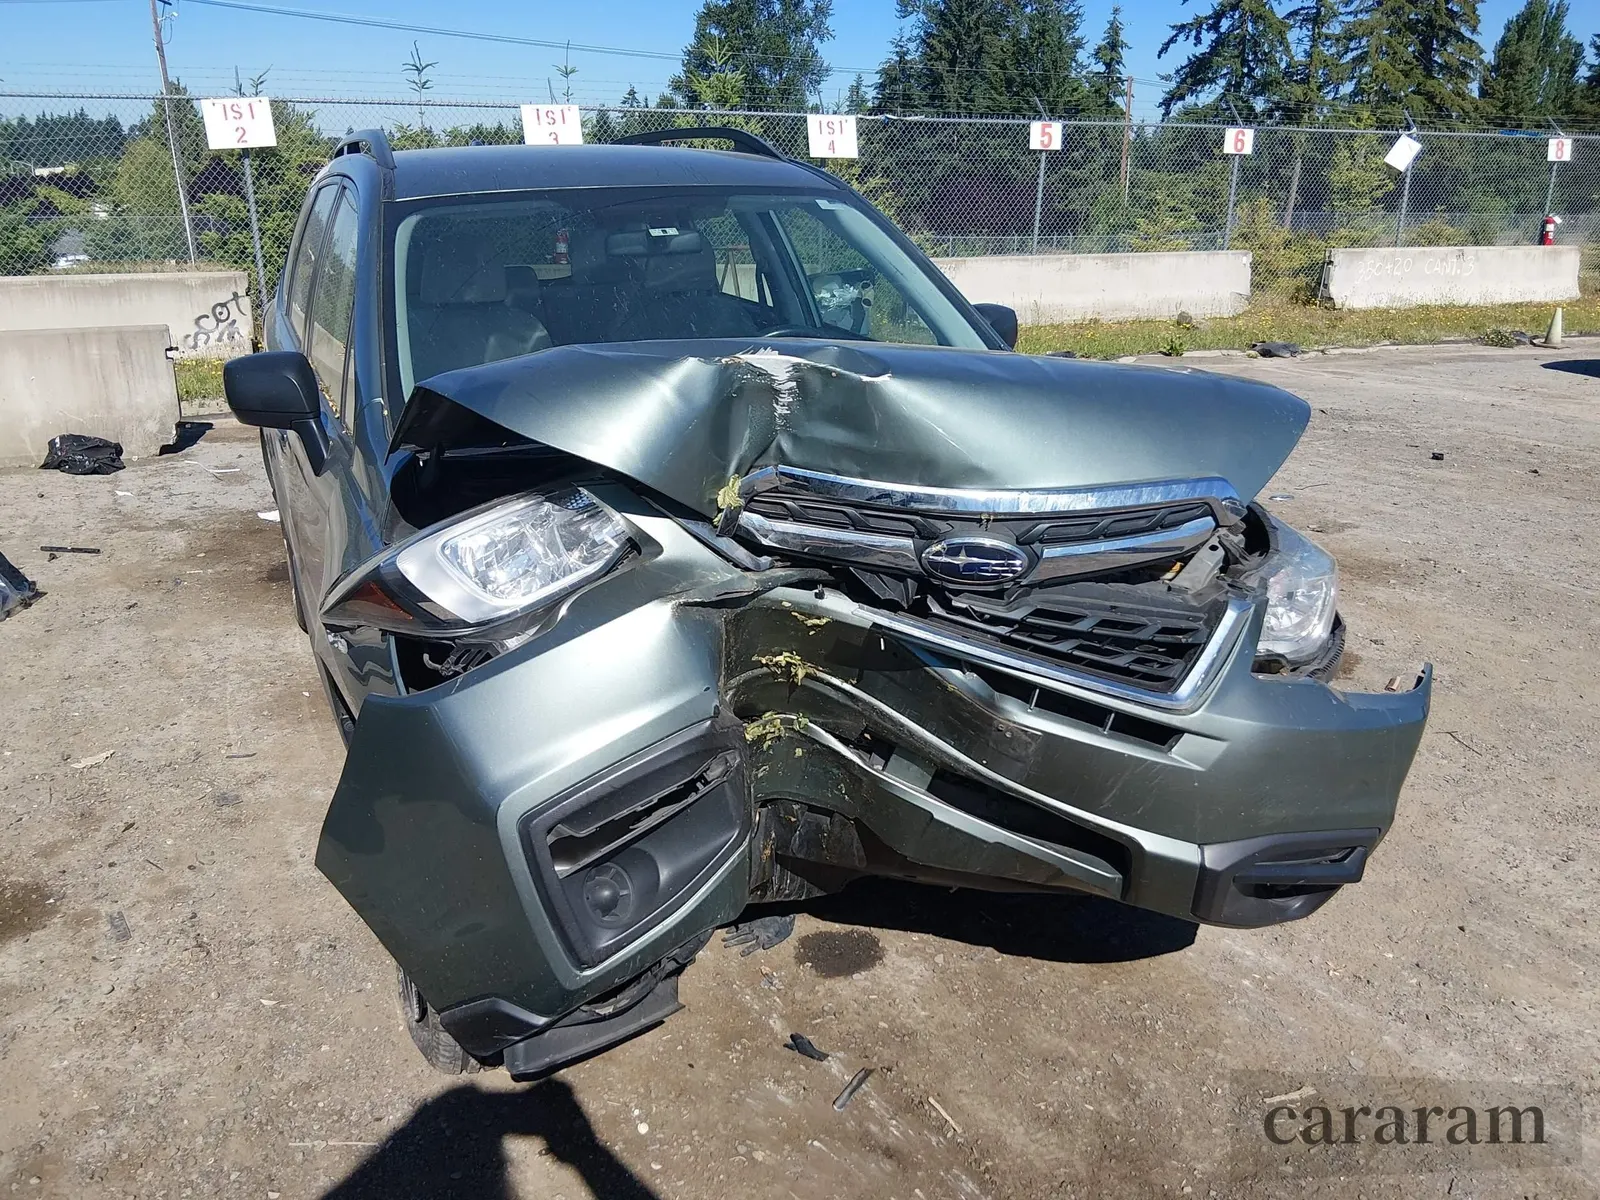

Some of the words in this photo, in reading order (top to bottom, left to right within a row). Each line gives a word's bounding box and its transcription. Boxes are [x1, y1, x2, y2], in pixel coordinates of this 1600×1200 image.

[235, 126, 248, 144] 2
[1040, 123, 1053, 149] 5
[1233, 129, 1246, 153] 6
[827, 139, 836, 155] 4
[1555, 139, 1565, 160] 8
